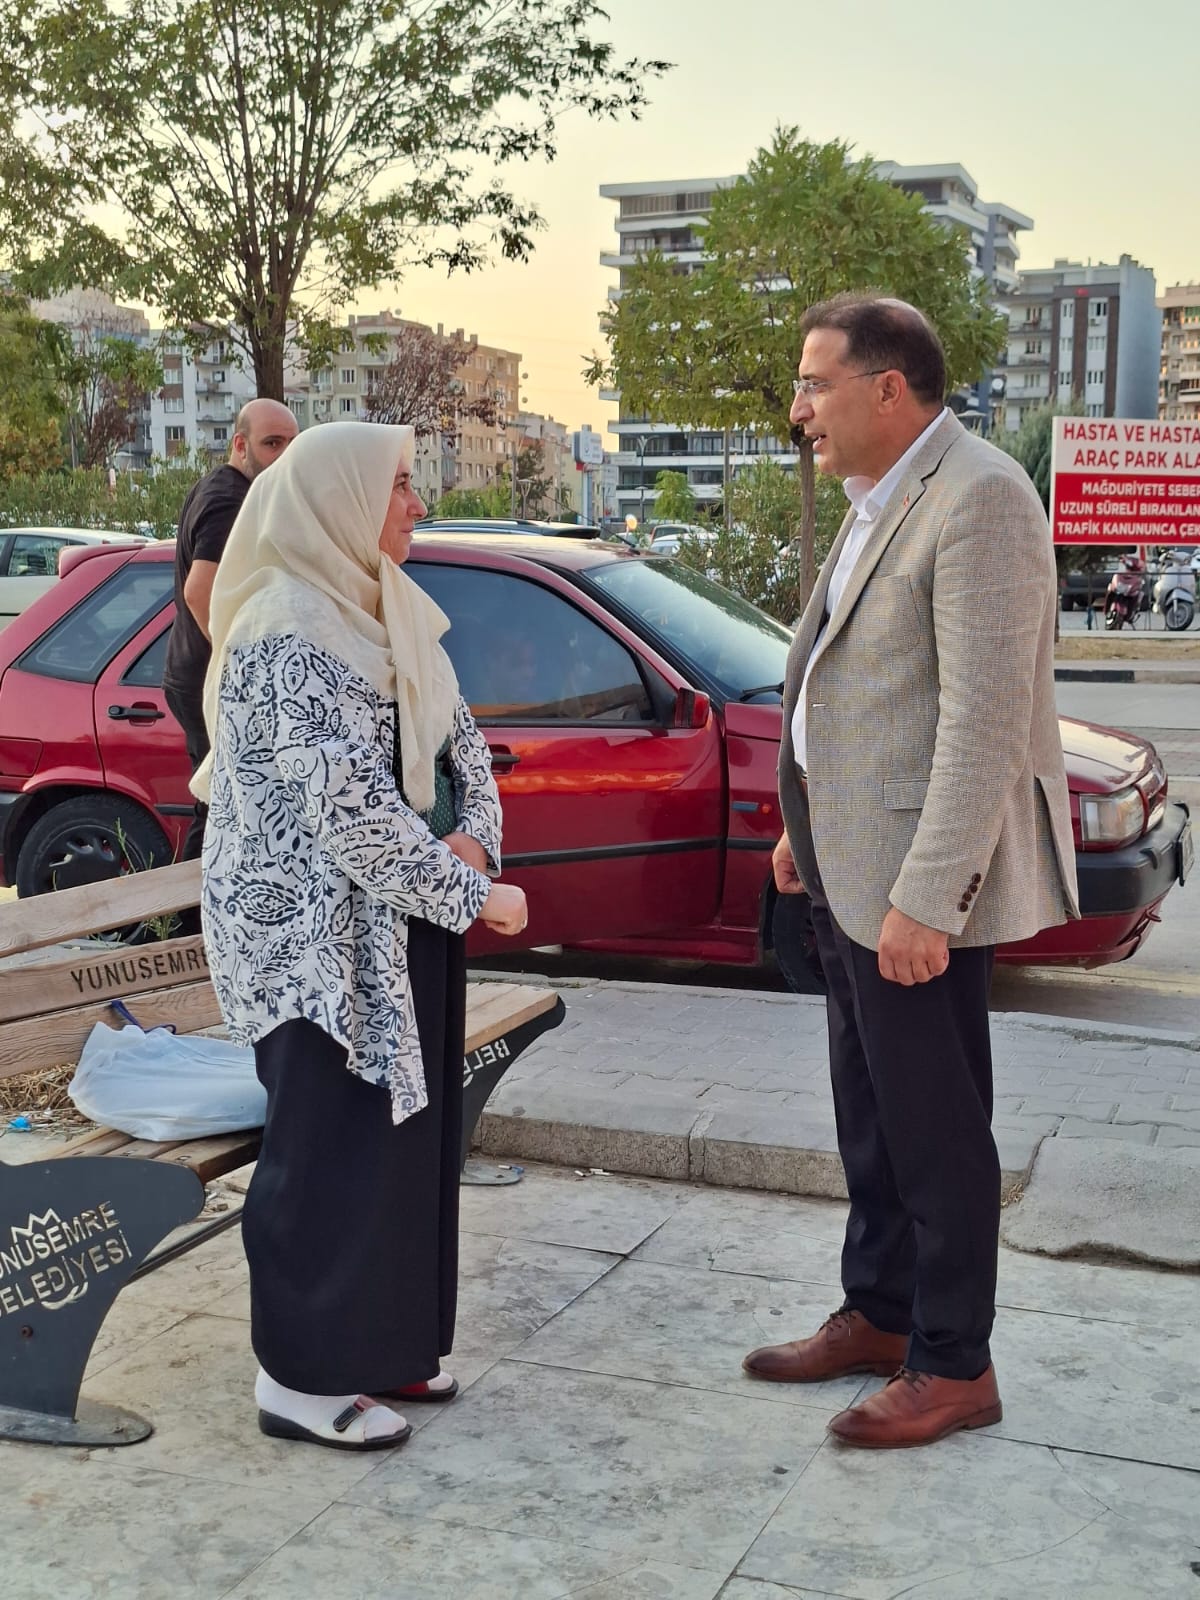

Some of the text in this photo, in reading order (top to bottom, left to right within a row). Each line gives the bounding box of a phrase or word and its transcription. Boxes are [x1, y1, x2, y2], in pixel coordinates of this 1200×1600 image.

[1063, 423, 1118, 441] HASTA
[1124, 425, 1145, 442] VE
[1073, 449, 1119, 469] ARAÇ
[1124, 450, 1167, 468] PARK
[1082, 479, 1165, 496] MAĞDURİYETE
[1060, 501, 1094, 515] UZUN
[1096, 499, 1137, 516] SÜRELİ
[1057, 519, 1100, 535] TRAFİK
[1103, 522, 1177, 536] KANUNUNCA
[0, 1228, 133, 1318] ELEDİYESİ
